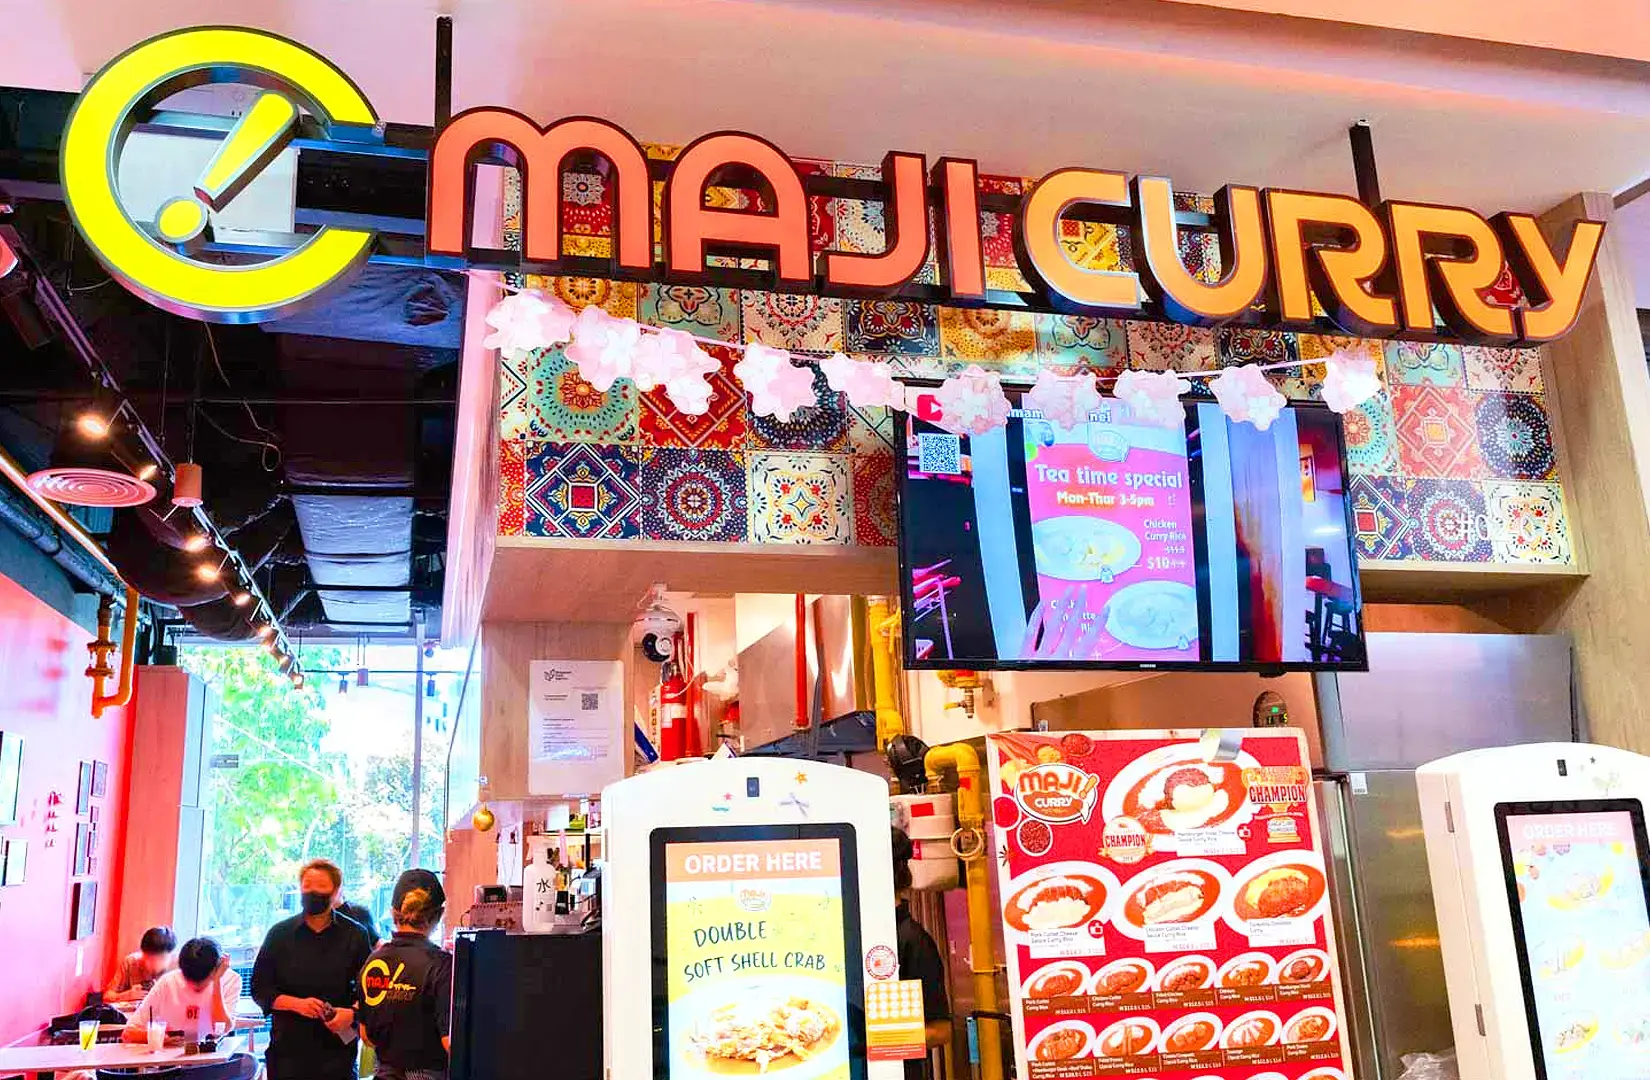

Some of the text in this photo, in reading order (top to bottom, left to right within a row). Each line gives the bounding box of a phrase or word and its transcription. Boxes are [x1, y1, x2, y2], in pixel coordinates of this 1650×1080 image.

[427, 105, 1607, 345] MAJI CURRY
[1034, 464, 1183, 490] Tea time special
[1056, 491, 1115, 505] Mon-Thur
[1144, 519, 1177, 529] Chicken
[1145, 532, 1169, 543] Curry
[1249, 784, 1306, 802] CHAMPION
[1034, 796, 1073, 808] CURRY
[1105, 834, 1146, 848] CHAMPION
[685, 851, 822, 874] ORDER HERE
[536, 878, 551, 893] 水
[694, 920, 767, 947] DOUBLE
[684, 951, 826, 982] SOFT SHELL CRAB
